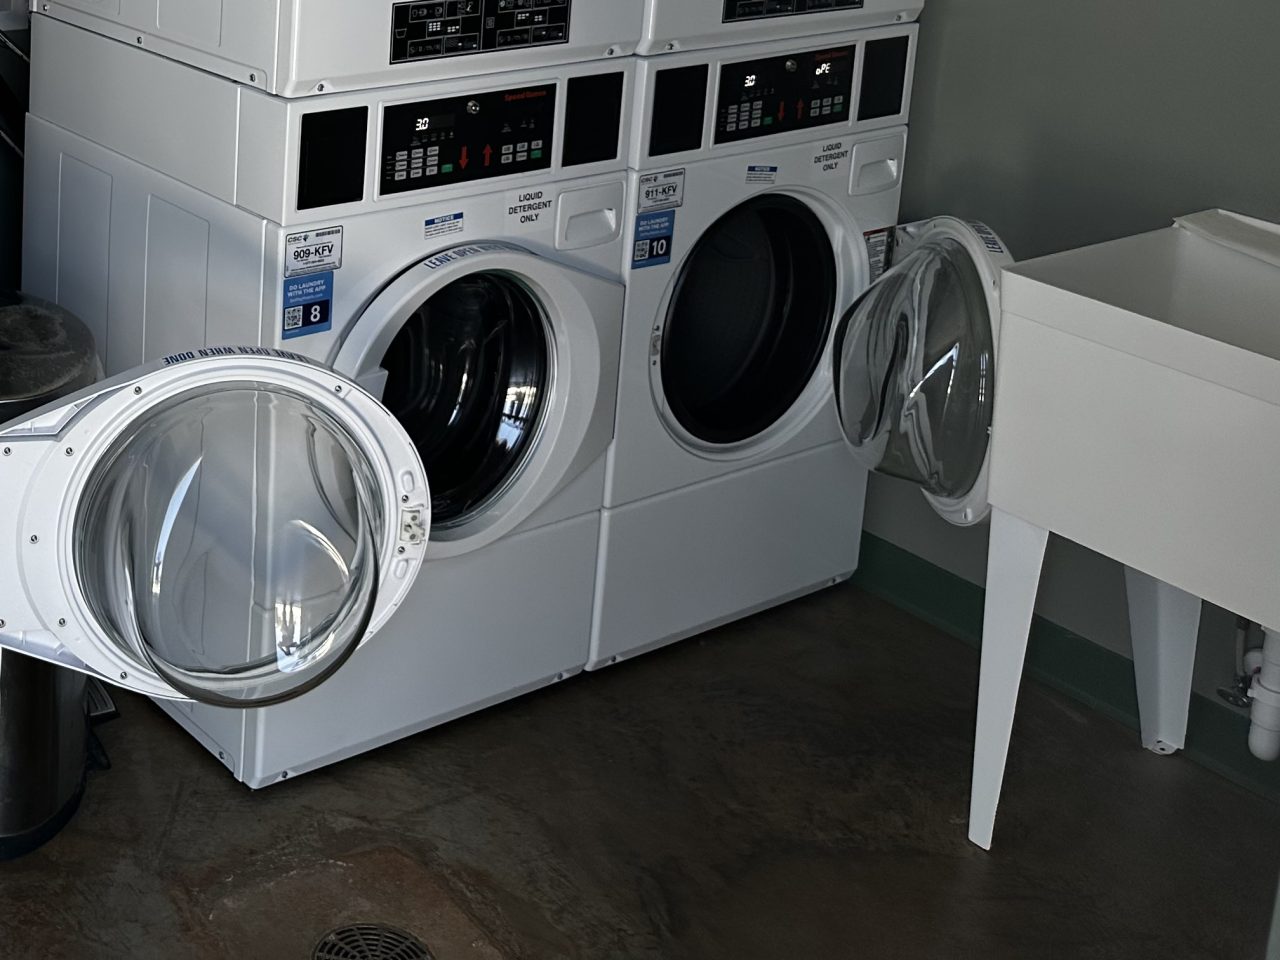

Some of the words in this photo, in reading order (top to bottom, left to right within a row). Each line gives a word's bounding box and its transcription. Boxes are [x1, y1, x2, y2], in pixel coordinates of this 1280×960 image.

[823, 142, 842, 152] LIQUID
[814, 151, 848, 163] DETERGENT
[823, 162, 838, 171] ONLY
[519, 191, 543, 202] LIQUID
[645, 184, 677, 198] 911-KFV
[509, 201, 552, 215] DETERGENT
[520, 213, 539, 223] ONLY
[294, 244, 334, 260] 909-KFV
[652, 239, 666, 255] 10
[424, 251, 456, 269] LEAVE
[299, 280, 324, 289] LAUNDRY
[311, 305, 320, 322] 8
[162, 351, 195, 366] DONE
[198, 347, 236, 357] WHEN
